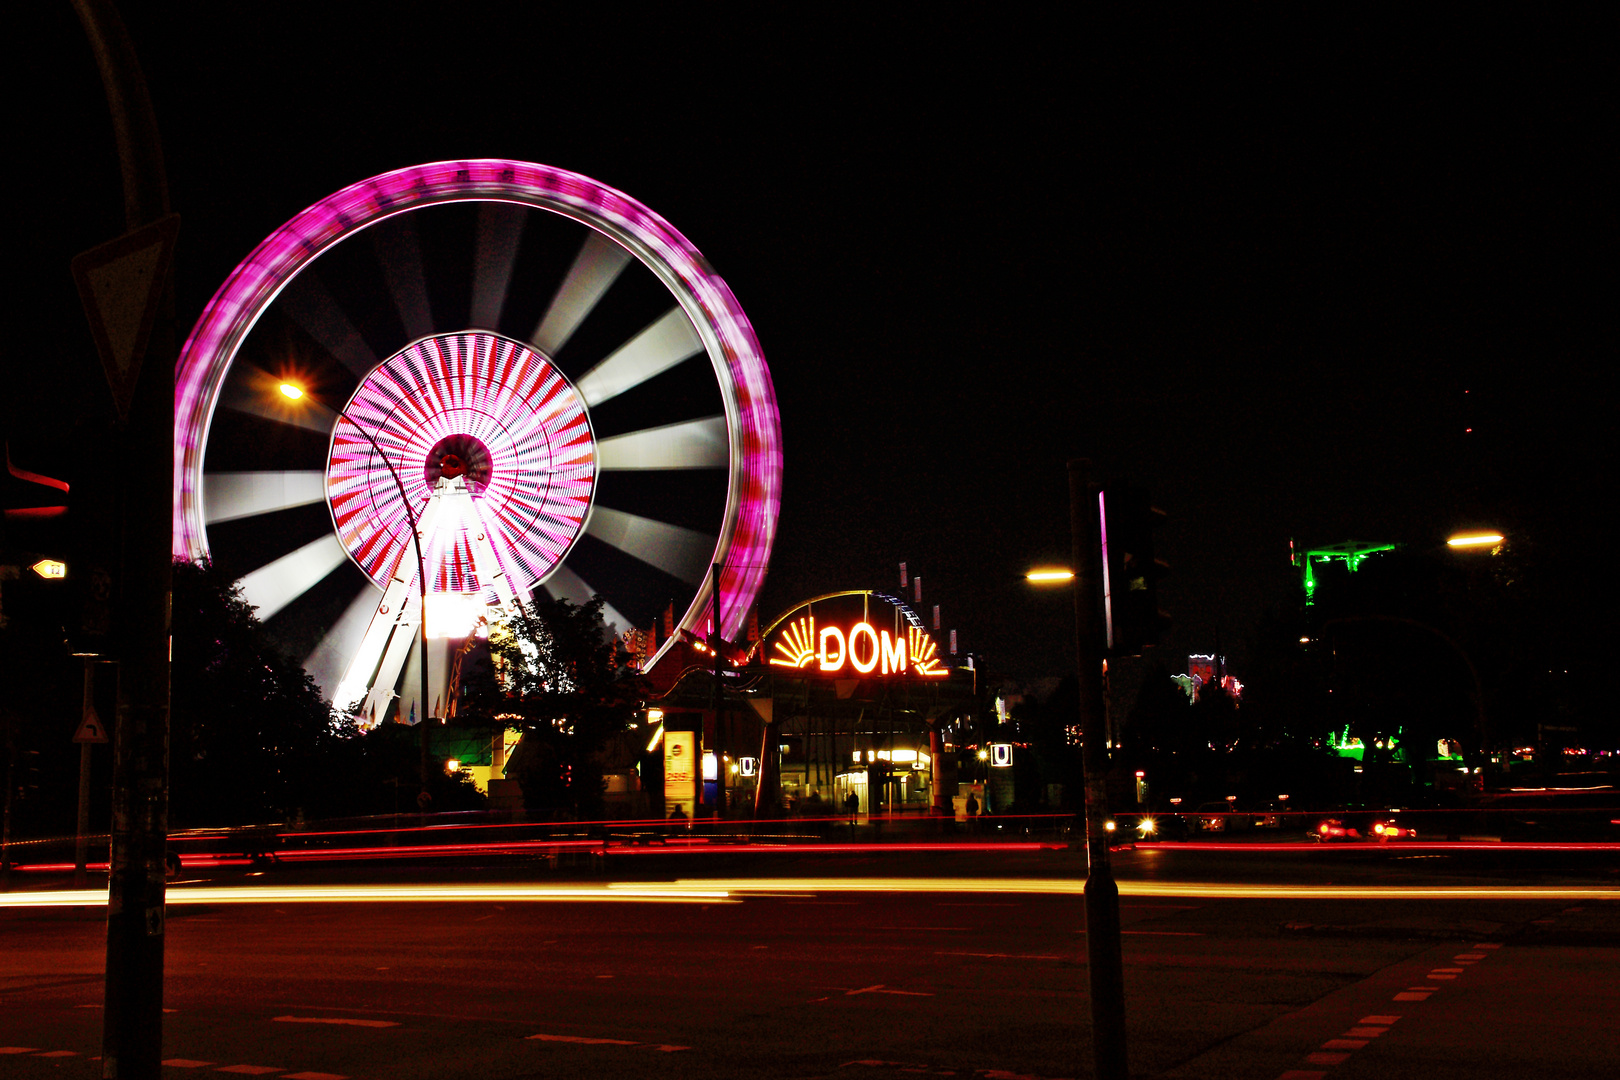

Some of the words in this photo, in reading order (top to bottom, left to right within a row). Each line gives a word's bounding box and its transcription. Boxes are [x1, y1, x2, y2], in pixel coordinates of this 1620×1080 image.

[820, 622, 907, 675] DOM
[993, 745, 1009, 765] U
[742, 757, 753, 775] U
